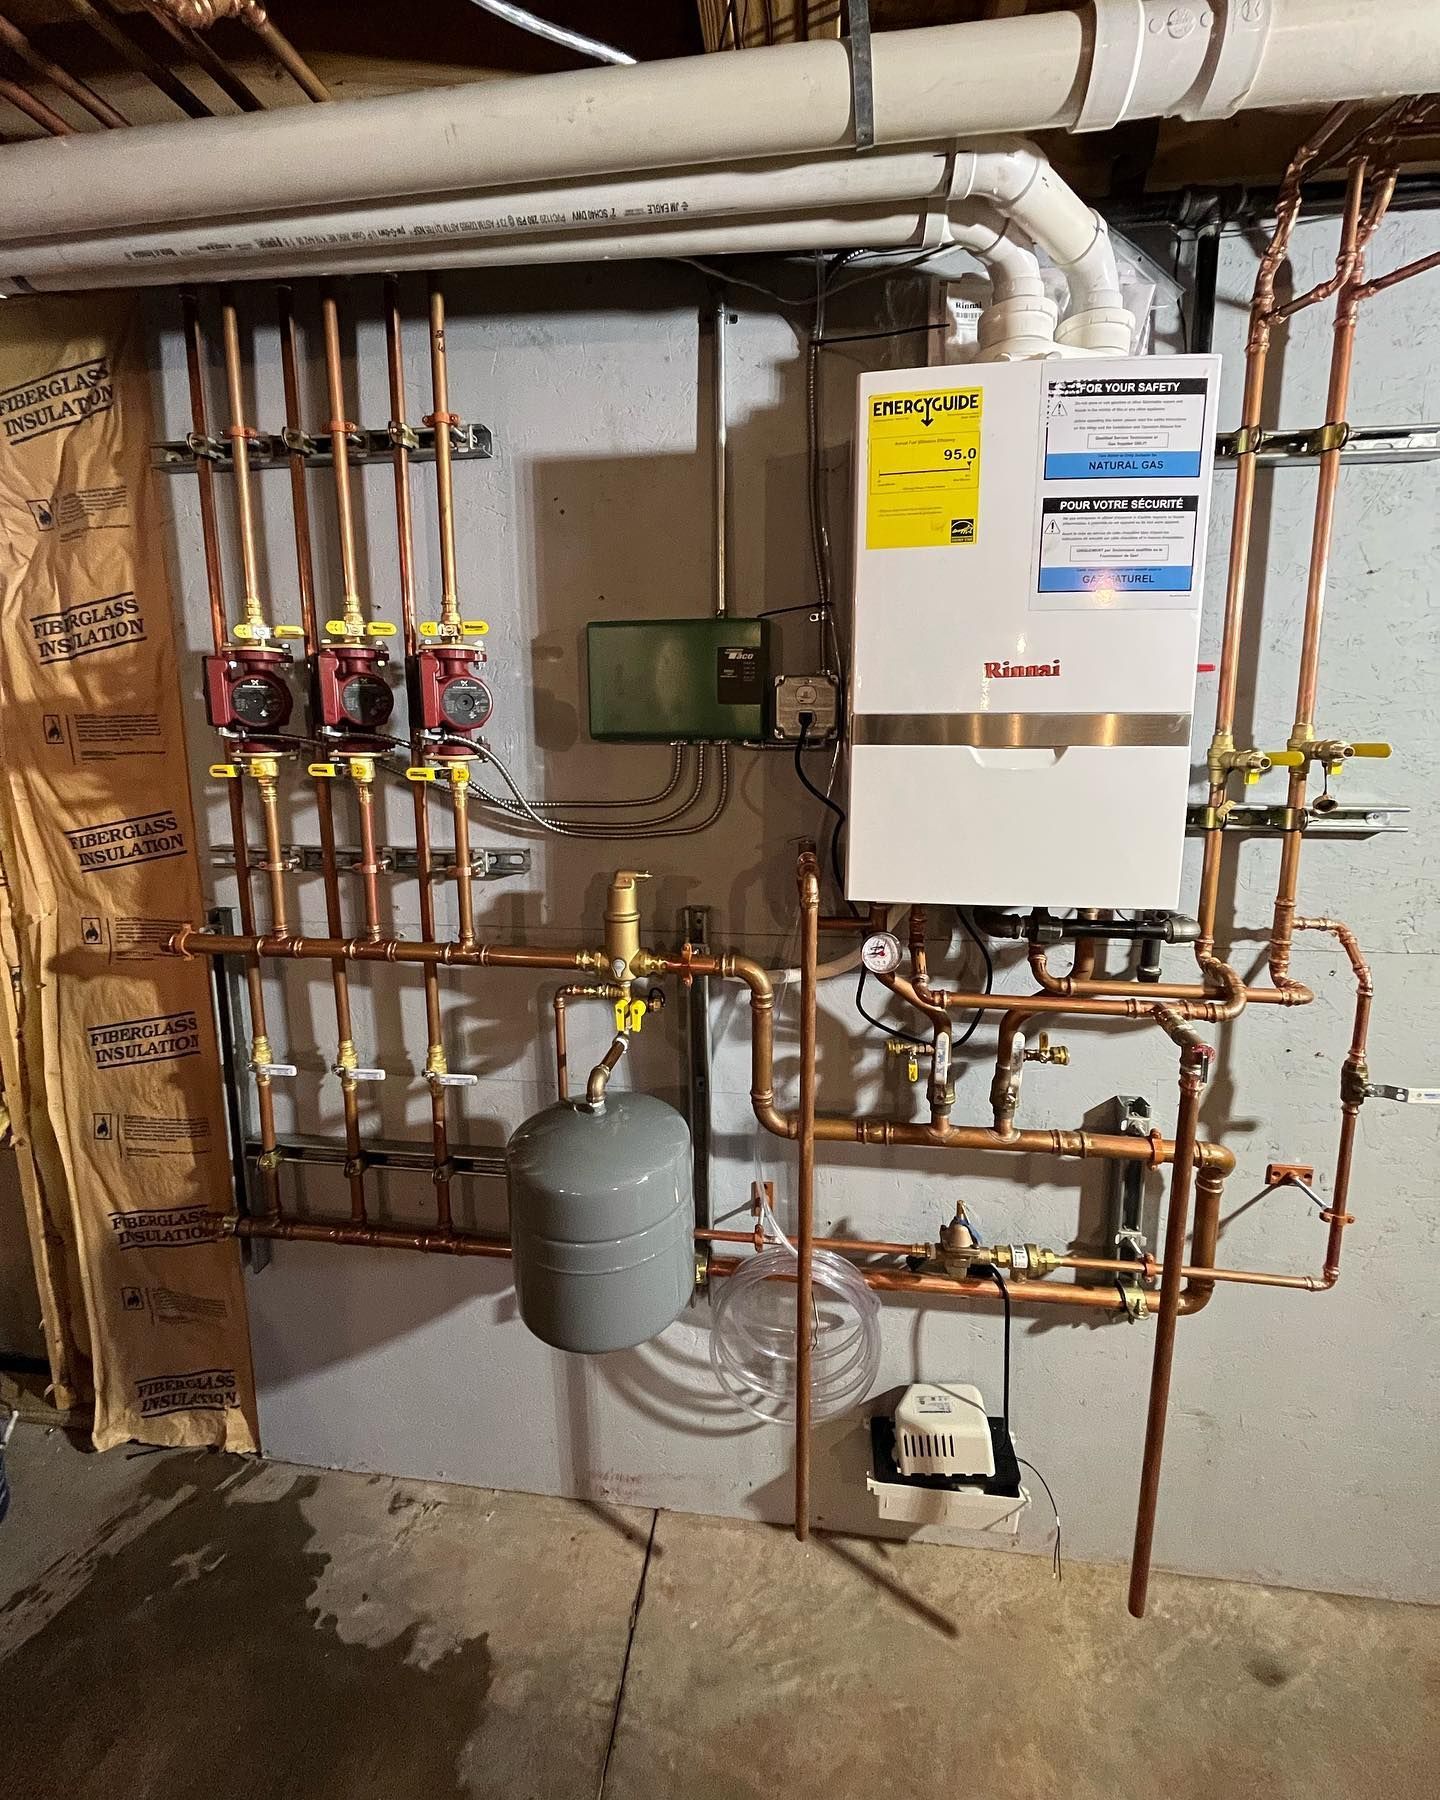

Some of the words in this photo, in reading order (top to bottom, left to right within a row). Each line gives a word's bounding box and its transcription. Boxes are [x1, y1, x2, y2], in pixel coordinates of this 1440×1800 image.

[572, 210, 588, 221] DWV
[588, 208, 608, 219] SCH40
[647, 203, 670, 214] EAGLE
[516, 216, 527, 226] PSI
[1080, 383, 1103, 393] FOR
[1105, 382, 1135, 393] YOUR
[1138, 382, 1181, 392] SAFETY
[873, 394, 979, 418] ENERGYGUIDE
[944, 447, 976, 461] 95.0
[1088, 460, 1139, 470] NATURAL
[1141, 460, 1164, 469] GAS
[1060, 500, 1091, 511] POUR
[1093, 499, 1128, 510] VOTRE
[1131, 497, 1184, 509] SÉCURITÉ
[984, 660, 1060, 678] Rinnai
[68, 817, 178, 849] FIBERGLASS
[78, 834, 184, 866] INSULATION
[91, 1017, 197, 1046] FIBERGLASS
